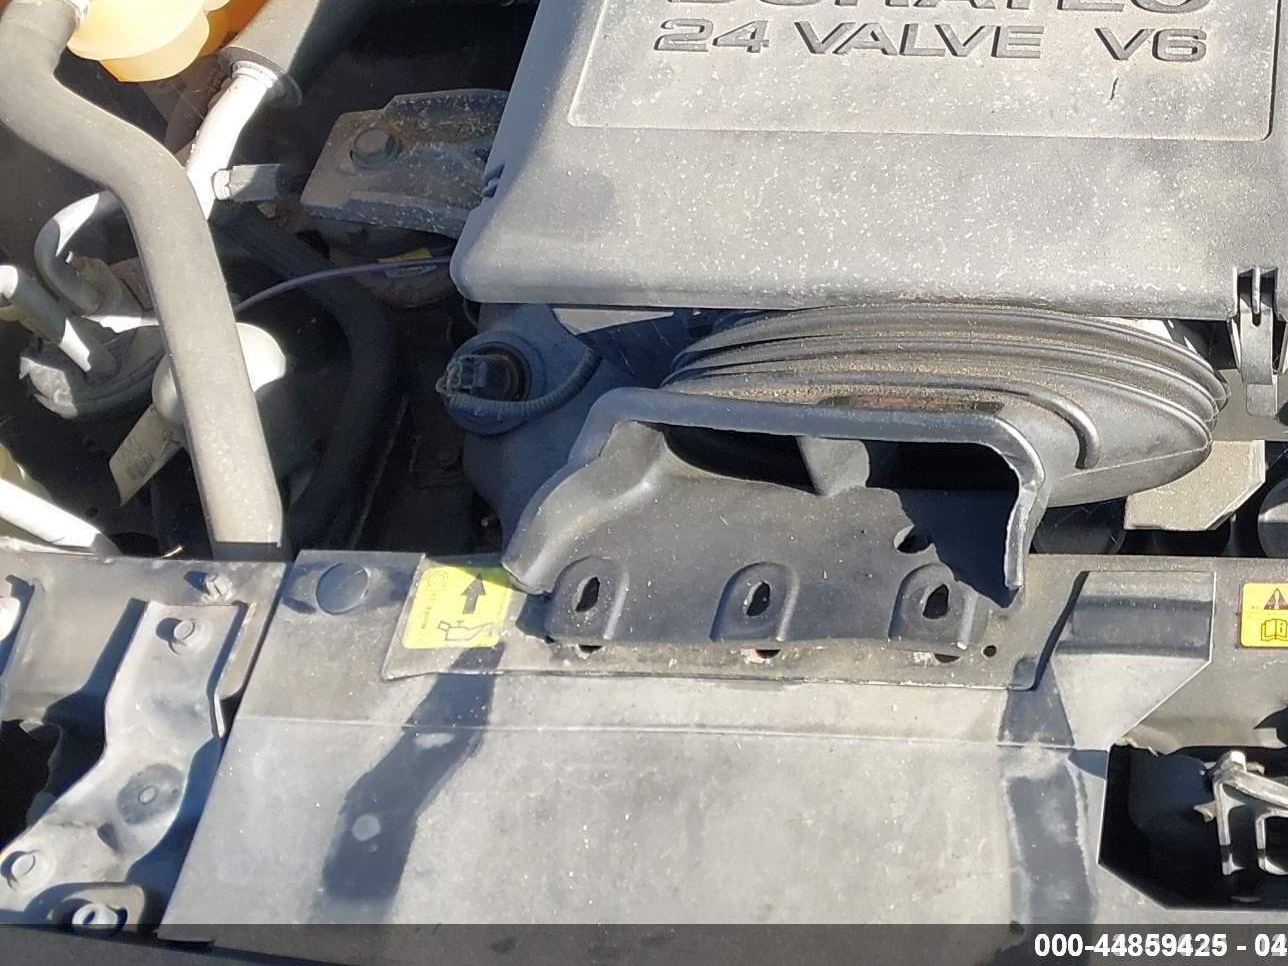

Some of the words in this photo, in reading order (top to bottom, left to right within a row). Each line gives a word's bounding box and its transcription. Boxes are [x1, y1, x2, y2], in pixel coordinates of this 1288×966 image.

[653, 18, 770, 54] 24
[793, 20, 1045, 59] VALVE
[1094, 25, 1208, 63] V6
